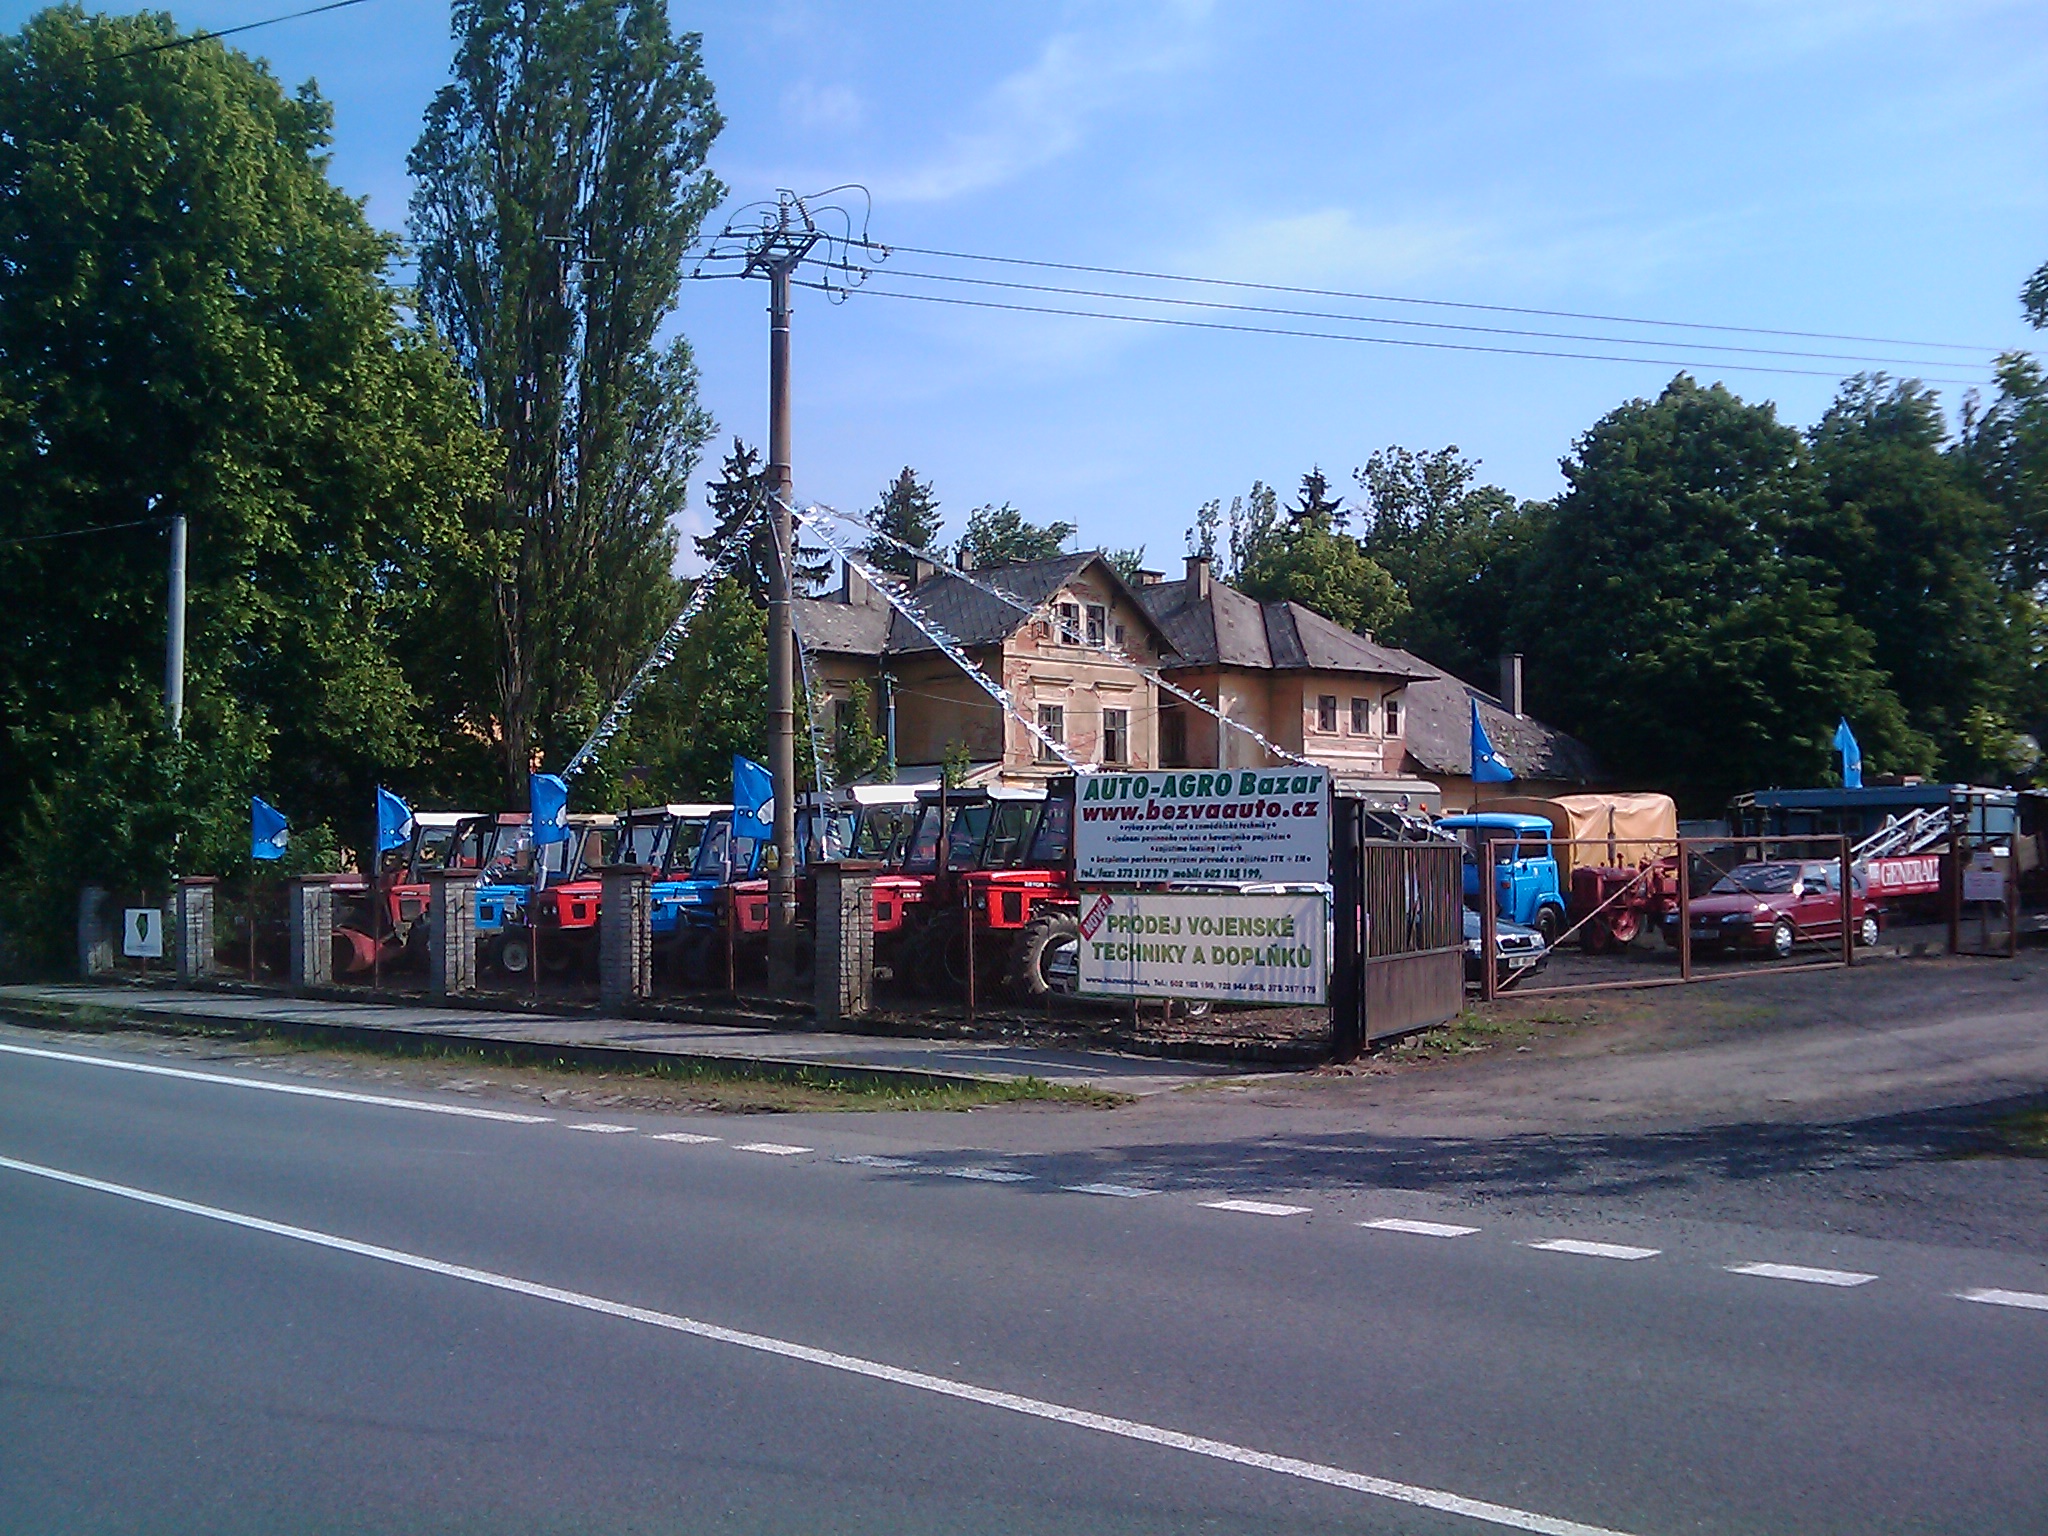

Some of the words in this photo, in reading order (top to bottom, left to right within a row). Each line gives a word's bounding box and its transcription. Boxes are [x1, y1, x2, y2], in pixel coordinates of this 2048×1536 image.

[1082, 773, 1233, 801] AUTO-AGRO
[1238, 772, 1323, 797] Bazar
[1082, 798, 1320, 821] www.bezvaauto.cz
[1106, 914, 1181, 936] PRODEJ
[1187, 913, 1295, 938] VOJENSKÉ
[1092, 942, 1187, 964] TECHNIKY
[1191, 946, 1206, 964] A
